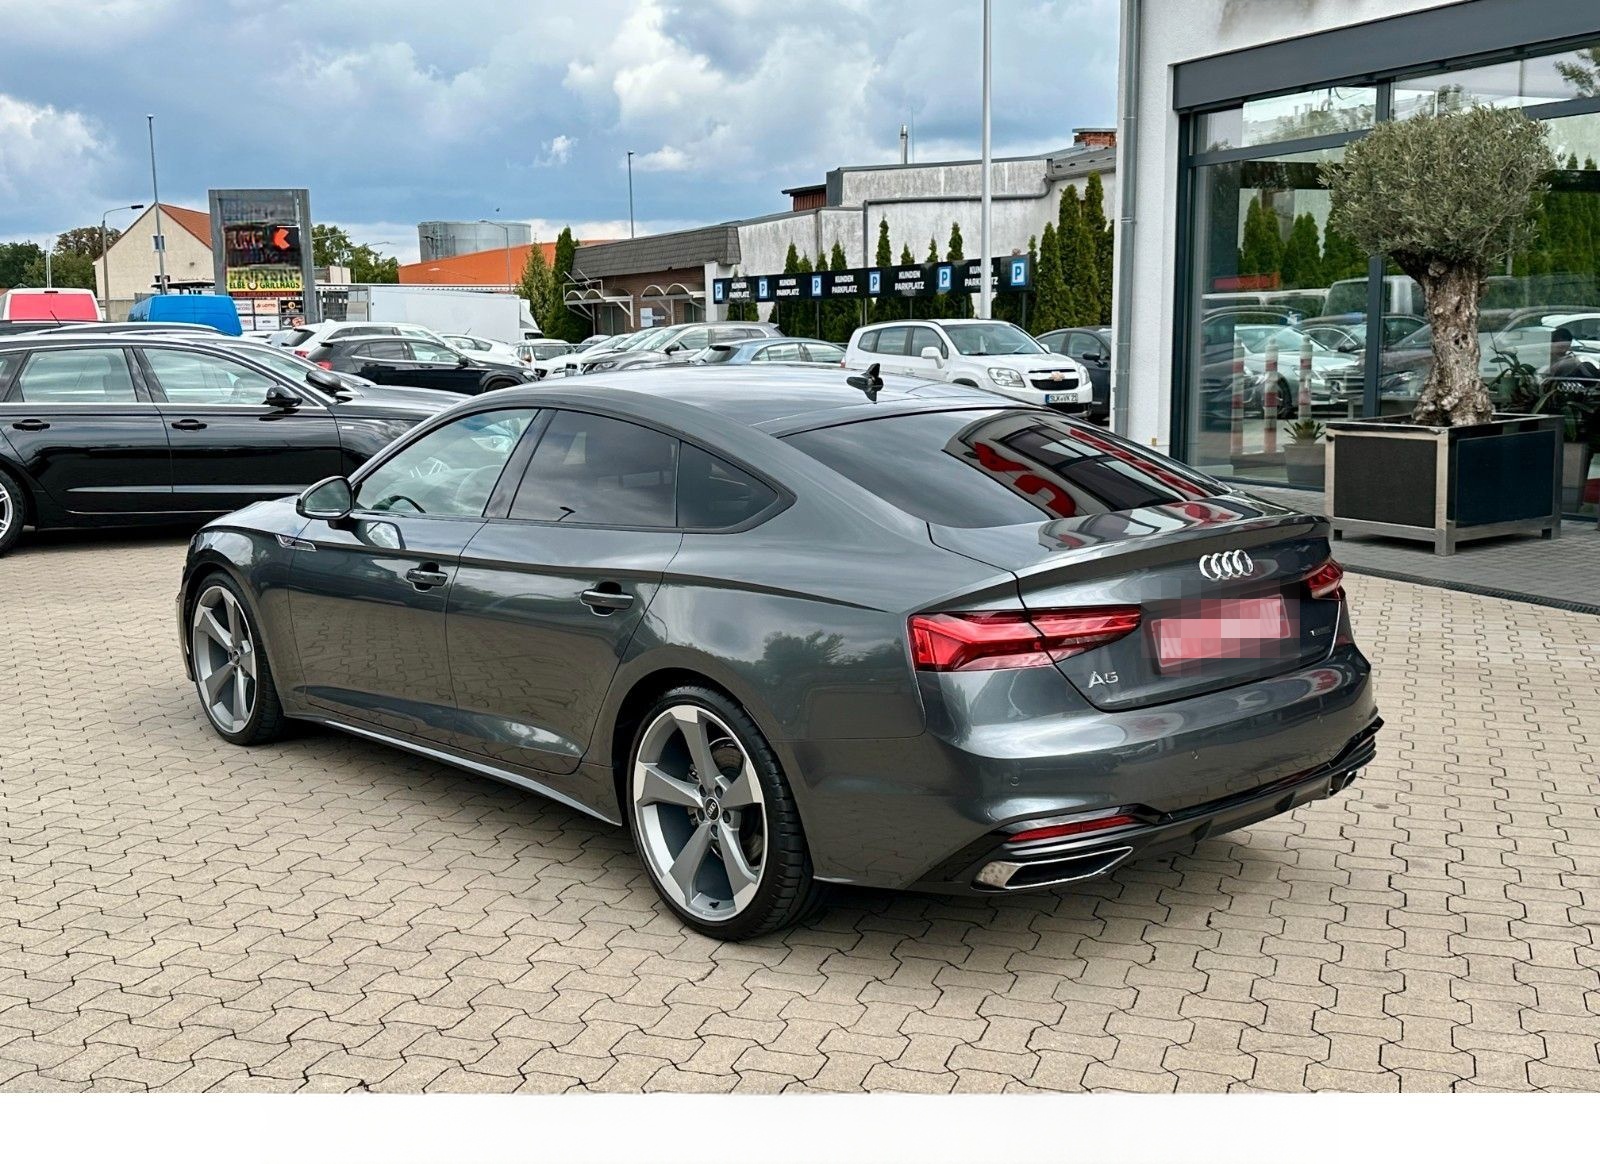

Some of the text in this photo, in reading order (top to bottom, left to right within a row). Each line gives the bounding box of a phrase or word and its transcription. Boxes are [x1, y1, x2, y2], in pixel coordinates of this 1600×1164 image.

[899, 270, 921, 280] KUNDEN
[969, 265, 994, 275] KUNN
[835, 275, 854, 284] KUNDEN
[964, 276, 999, 287] PARKTZ
[831, 285, 858, 294] PARKPLATZ
[894, 281, 925, 291] PARKPLATZ
[776, 288, 800, 297] PARKPLATZ
[1088, 671, 1118, 688] A5
